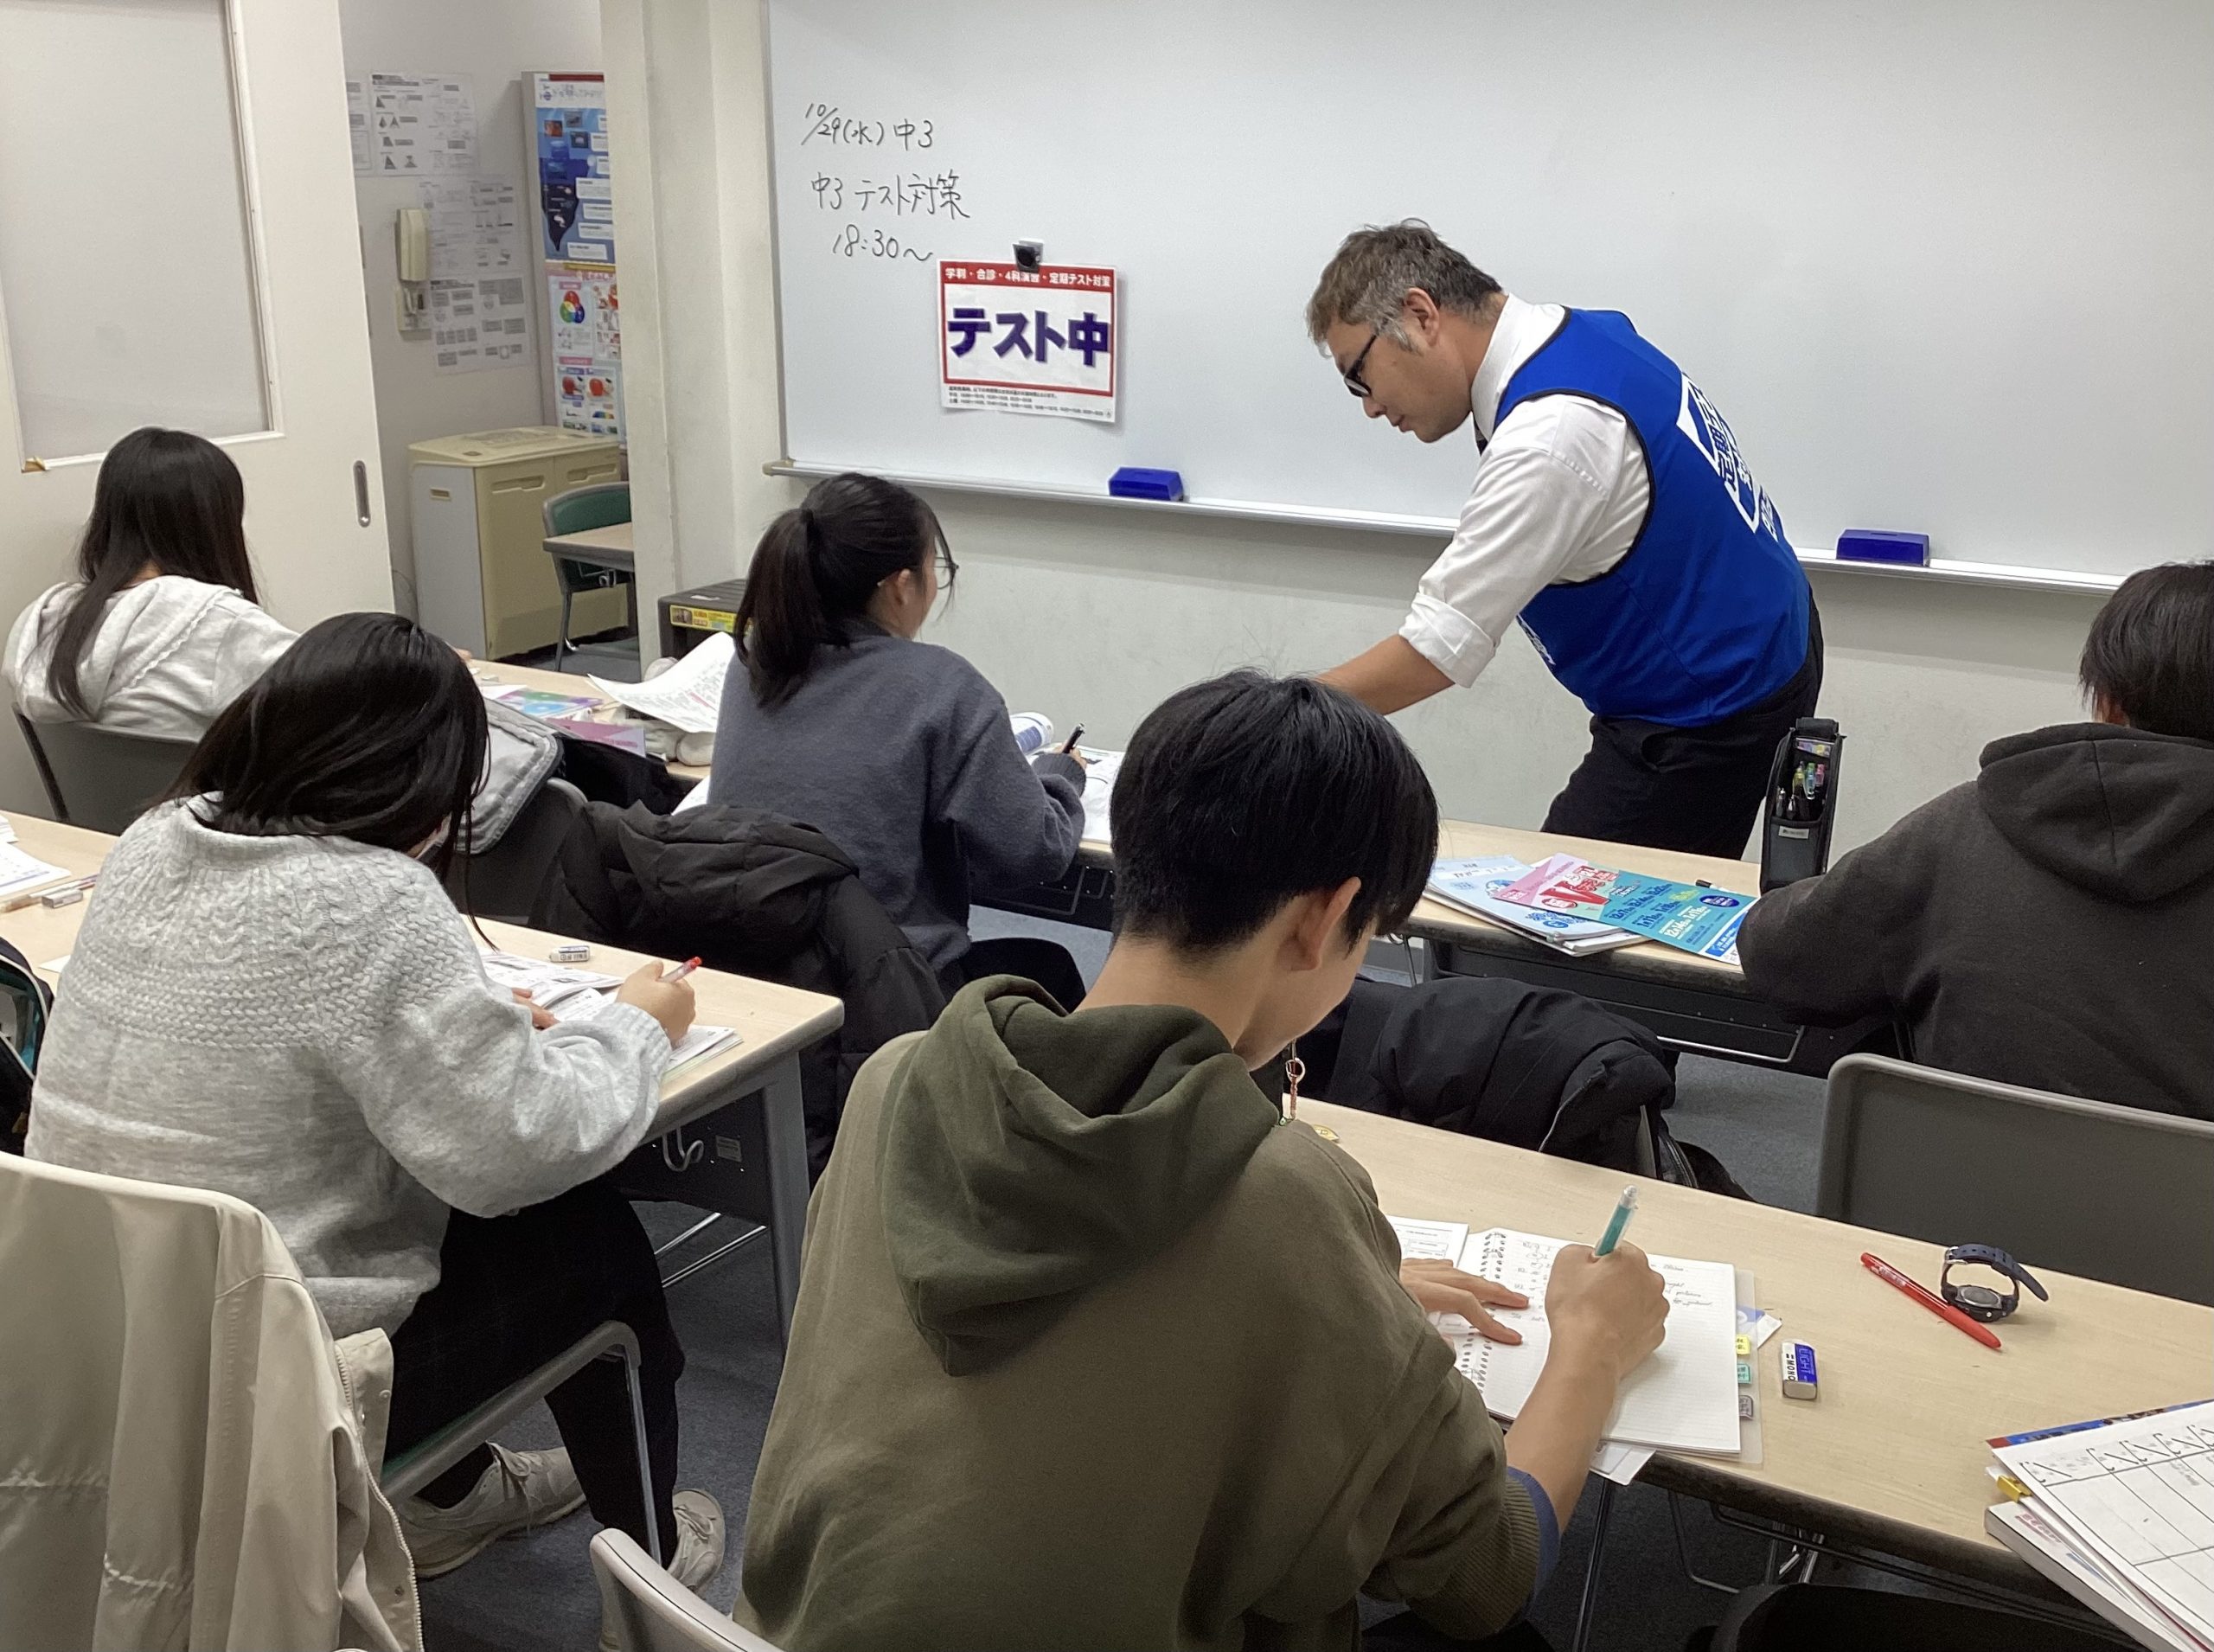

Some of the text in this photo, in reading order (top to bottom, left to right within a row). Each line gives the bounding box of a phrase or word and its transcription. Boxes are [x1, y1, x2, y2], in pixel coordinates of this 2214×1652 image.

[893, 118, 934, 150] 中3
[811, 169, 970, 219] 中3 テスト対策
[947, 307, 1110, 367] テスト中
[1786, 1360, 1796, 1381] MONO
